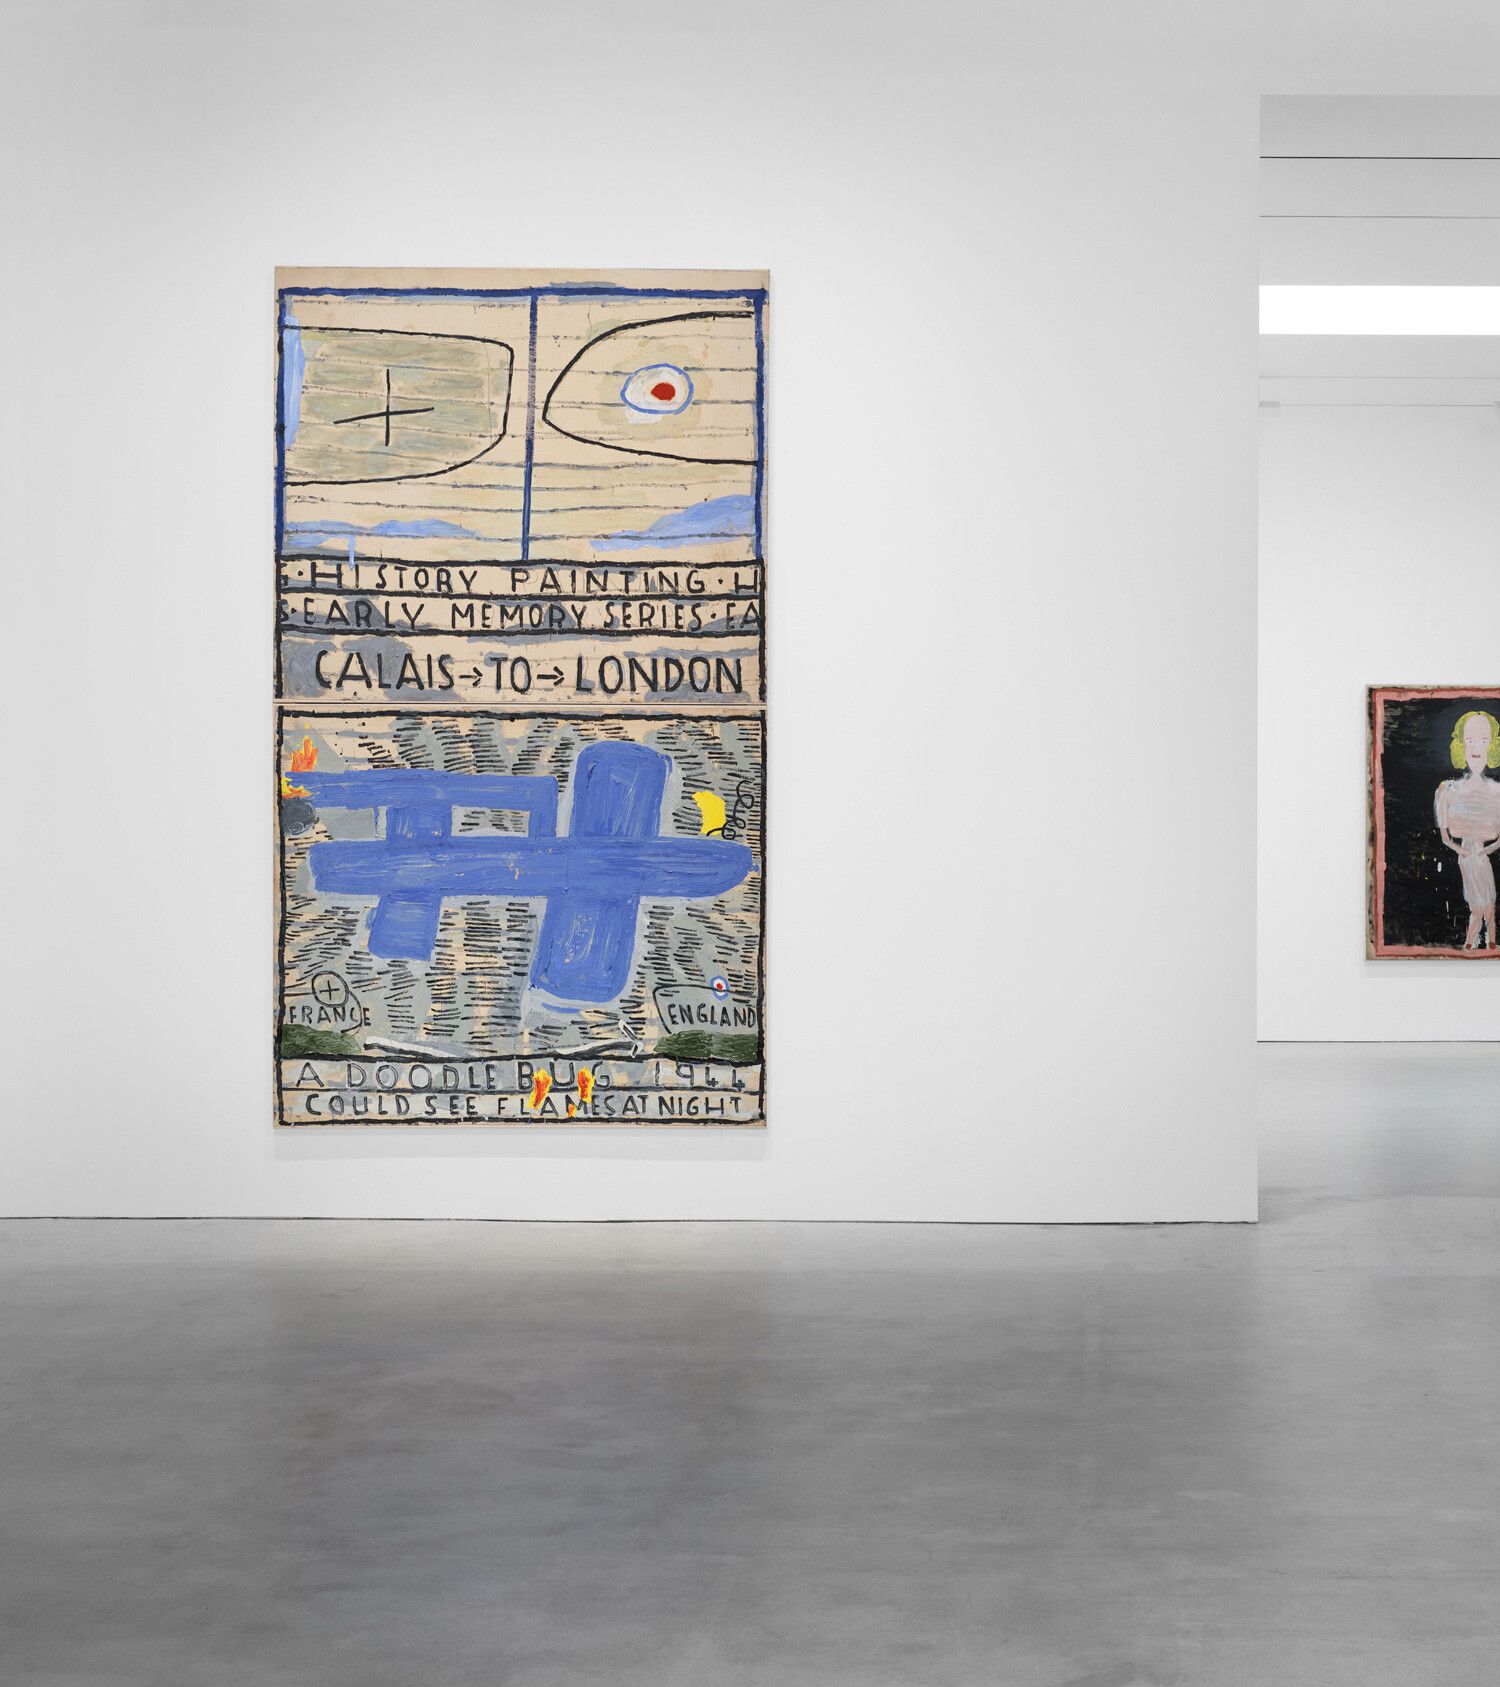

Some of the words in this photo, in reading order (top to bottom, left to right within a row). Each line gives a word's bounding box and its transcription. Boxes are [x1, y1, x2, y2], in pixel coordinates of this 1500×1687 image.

[451, 601, 586, 630] MEMORY
[315, 650, 454, 691] CALAIS
[490, 656, 532, 694] TO
[576, 655, 743, 694] LONDON
[289, 1006, 371, 1026] FRANCE
[668, 1003, 756, 1028] ENGLAND
[296, 1062, 325, 1089] A
[347, 1062, 496, 1092] DOODLE
[517, 1061, 611, 1090] BUG
[654, 1061, 746, 1093] 1944
[305, 1093, 410, 1117] COULD
[425, 1095, 477, 1117] SEE
[497, 1094, 616, 1117] FLAMES
[622, 1095, 649, 1116] AT
[658, 1095, 742, 1117] NIGHT
